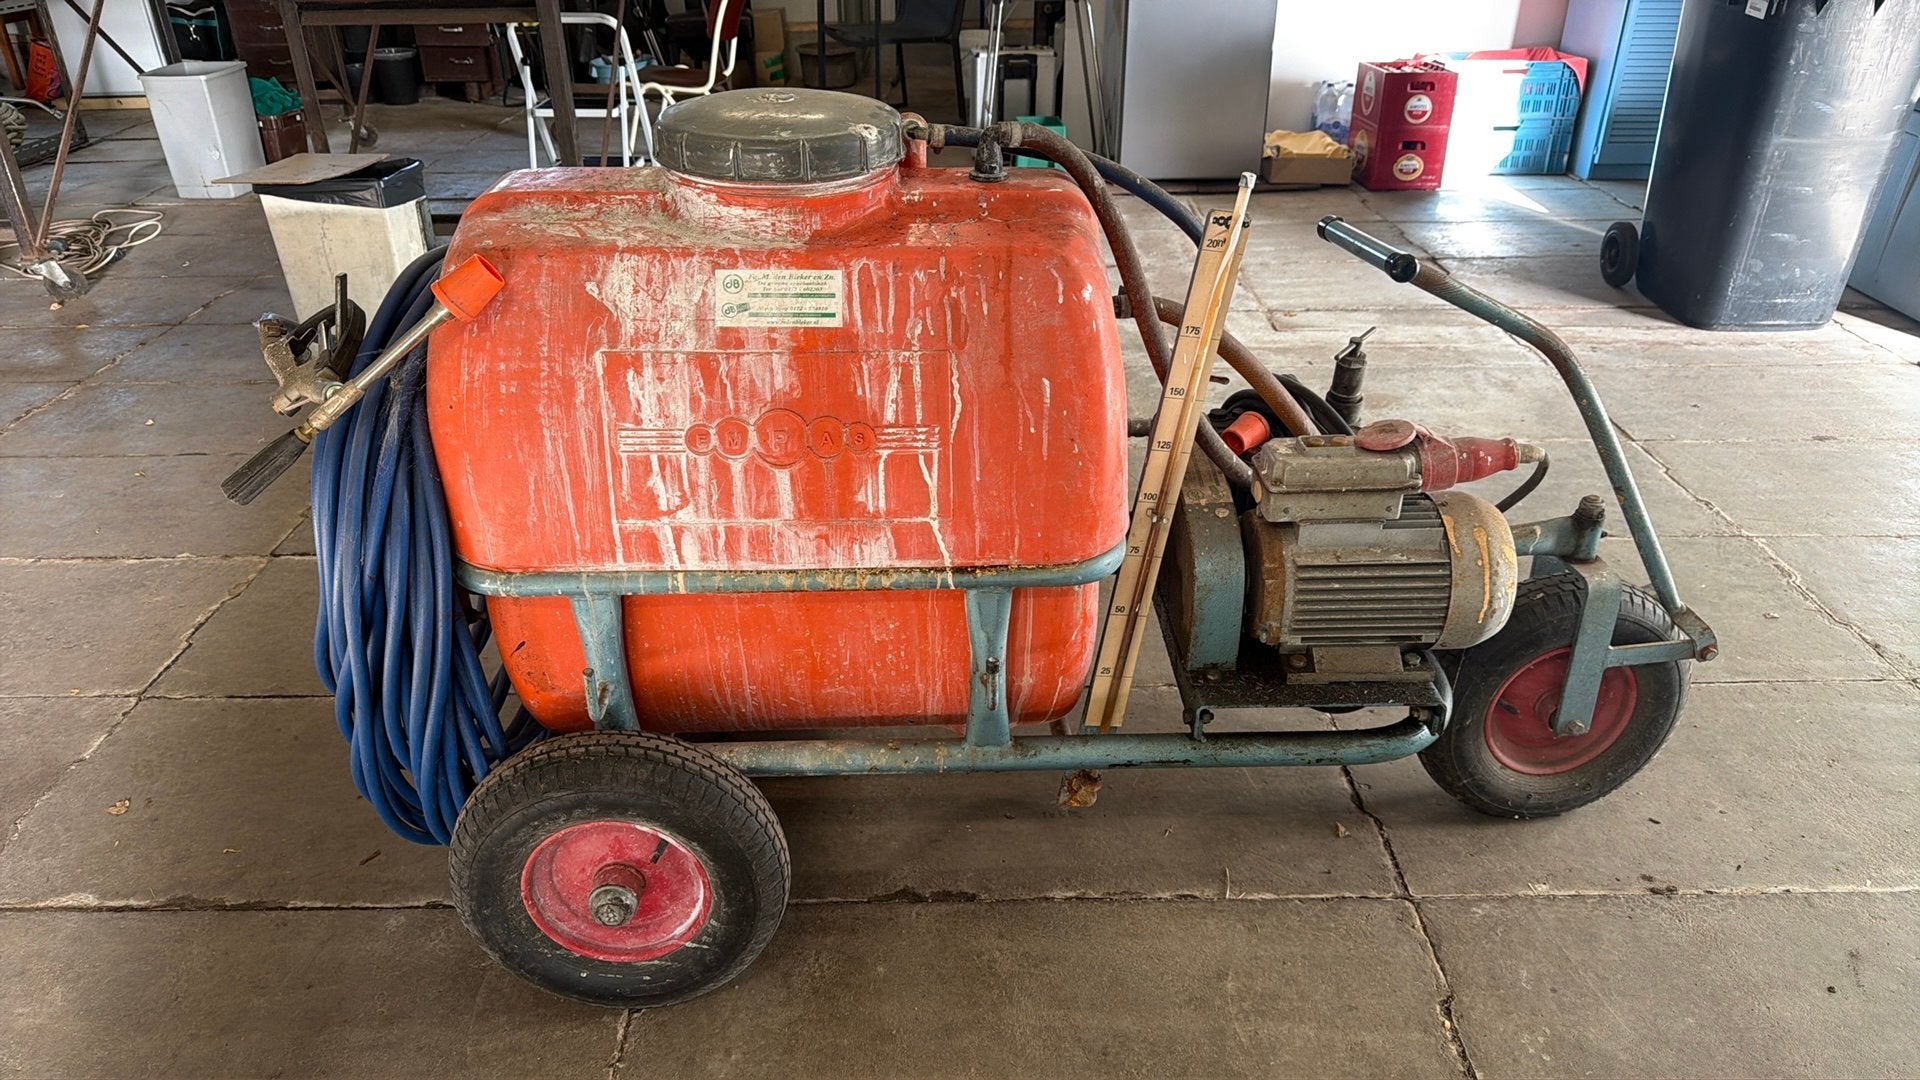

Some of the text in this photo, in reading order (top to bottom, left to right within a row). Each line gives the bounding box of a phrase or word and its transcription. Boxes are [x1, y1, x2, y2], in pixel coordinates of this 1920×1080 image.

[1185, 325, 1200, 335] 175
[1169, 387, 1185, 396] 150
[1156, 440, 1172, 449] 125
[1142, 492, 1158, 501] 100
[1129, 546, 1139, 554] 75
[1115, 605, 1126, 613] 50
[1101, 667, 1111, 675] 25
